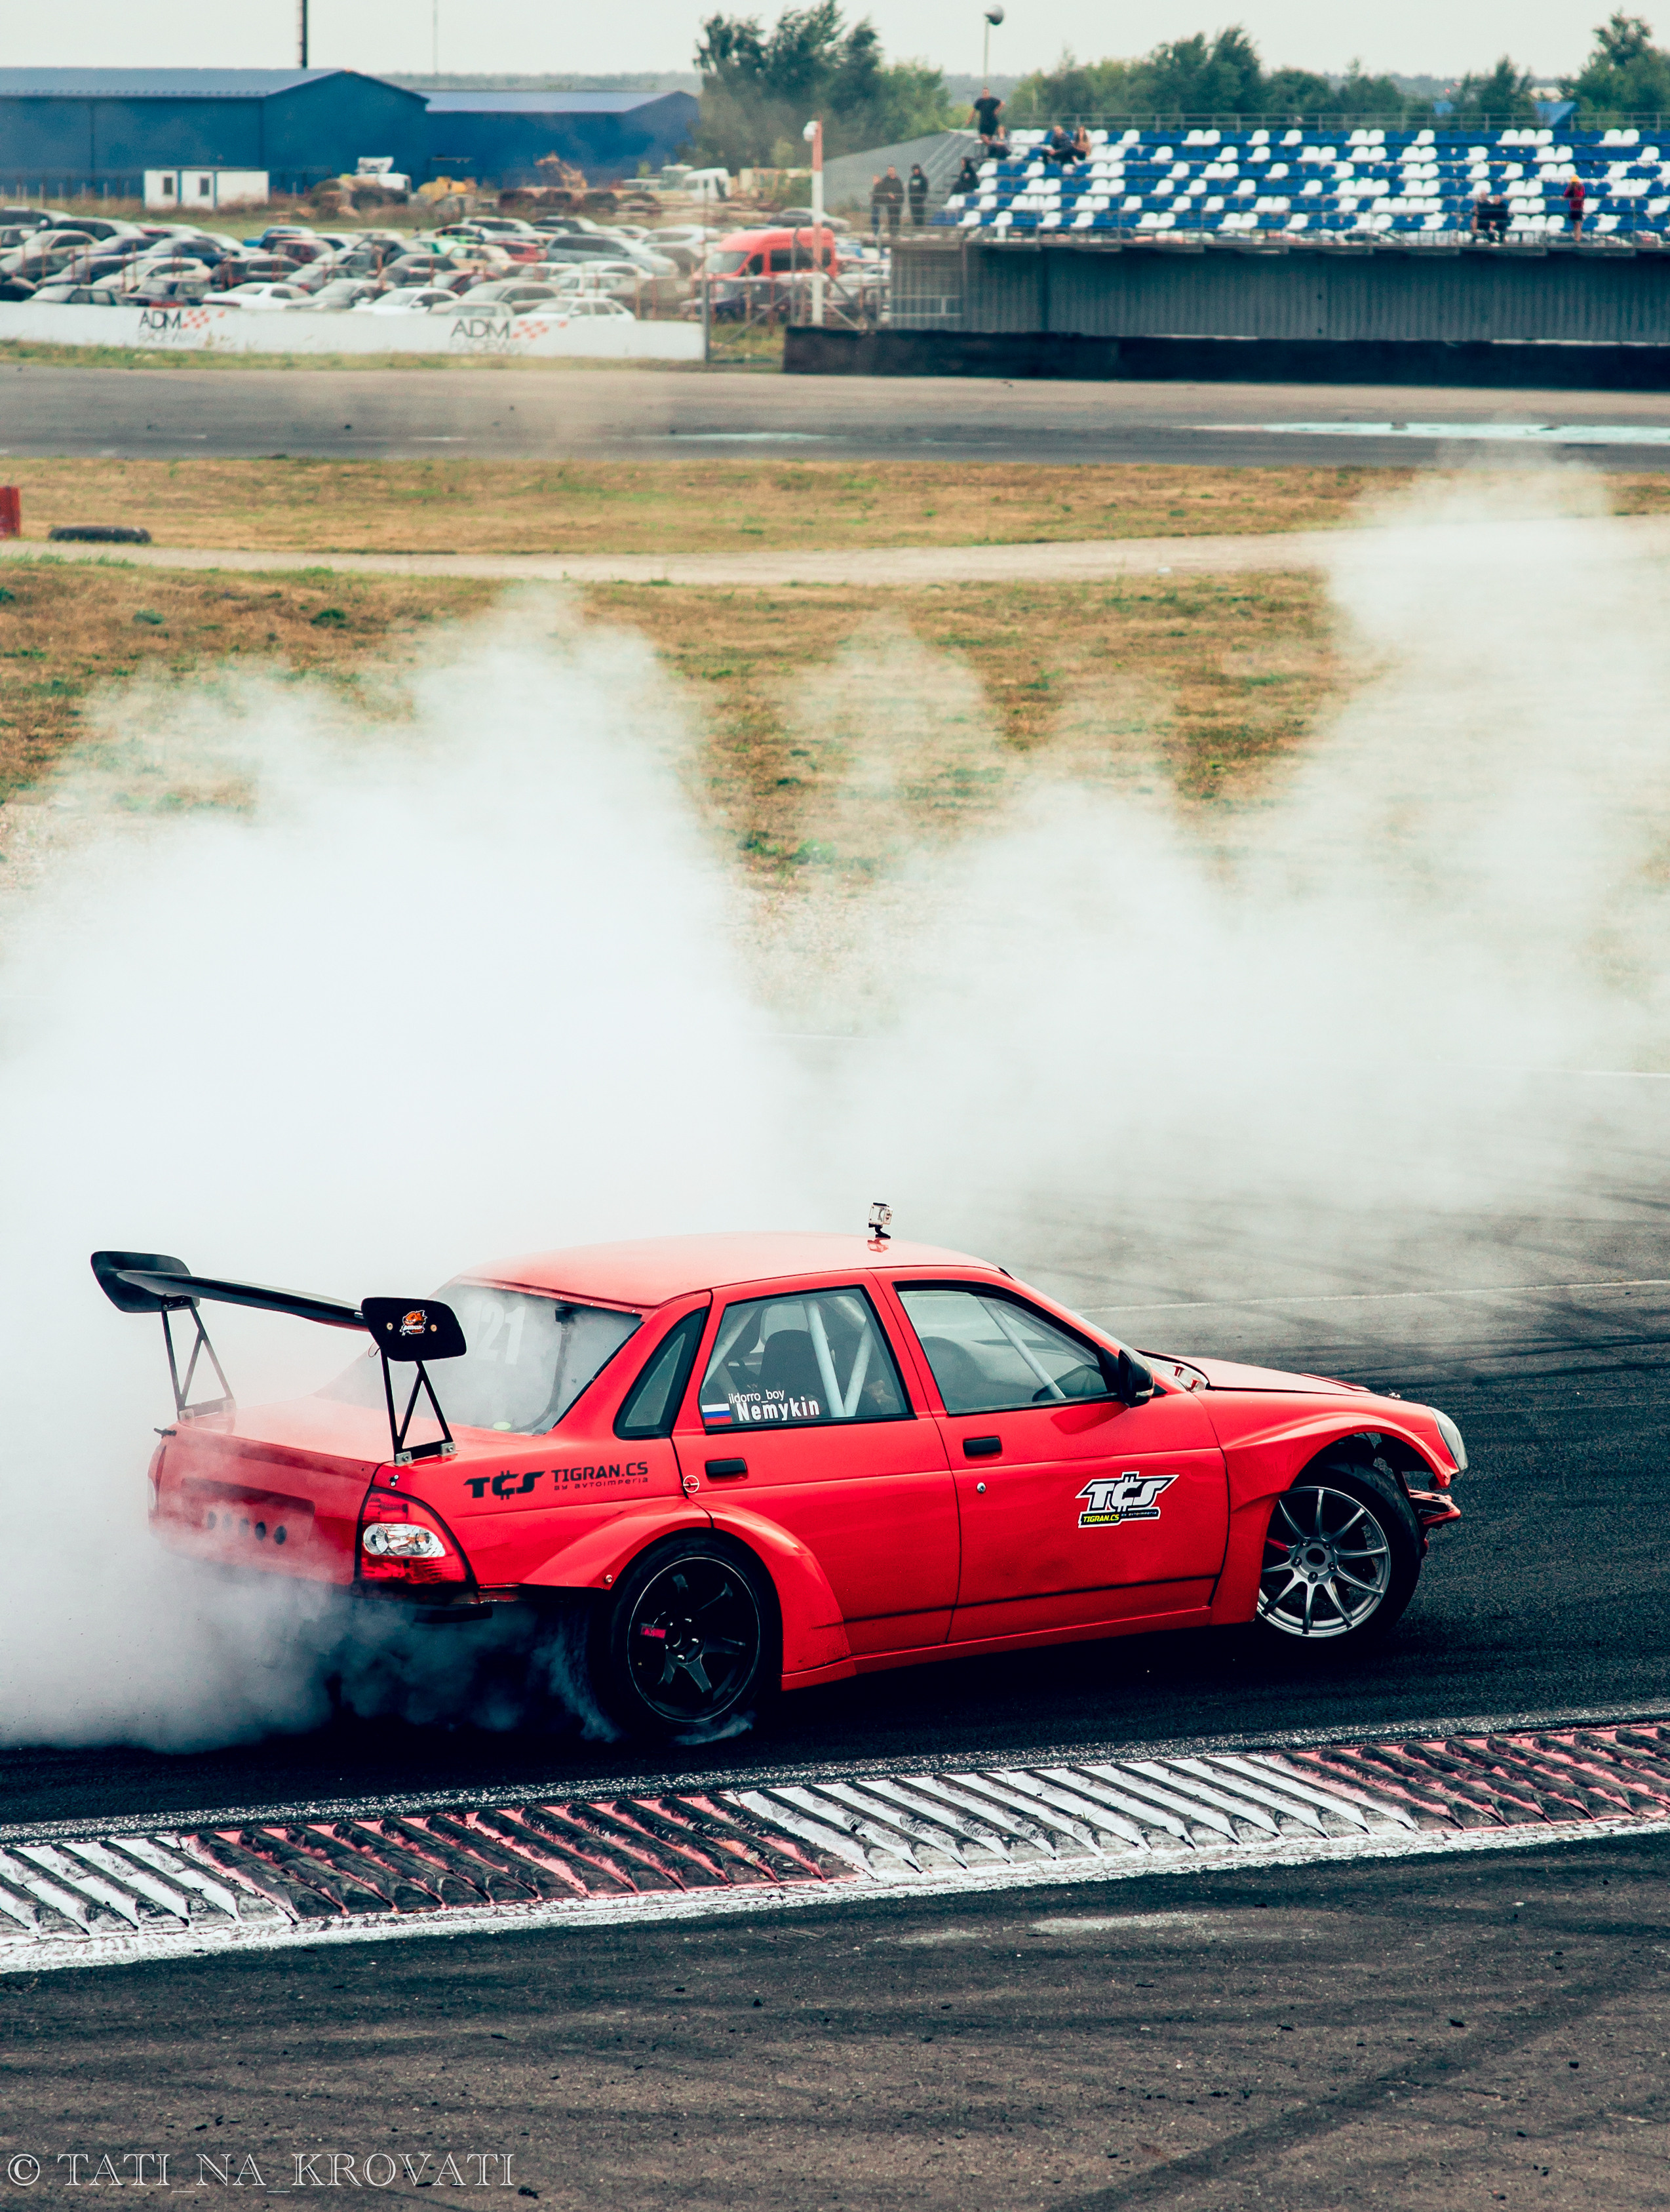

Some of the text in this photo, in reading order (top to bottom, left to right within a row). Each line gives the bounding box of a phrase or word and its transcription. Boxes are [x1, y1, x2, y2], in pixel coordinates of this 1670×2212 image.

[138, 309, 182, 329] ADM
[450, 319, 510, 339] ADM
[462, 1299, 526, 1365] 121
[728, 1389, 785, 1404] ildorro_boy
[736, 1396, 820, 1421] Nemykin
[463, 1461, 648, 1500] TCS TIGRAN.CS
[1087, 1476, 1168, 1512] TCS
[1083, 1514, 1119, 1523] TIGRAN.CS
